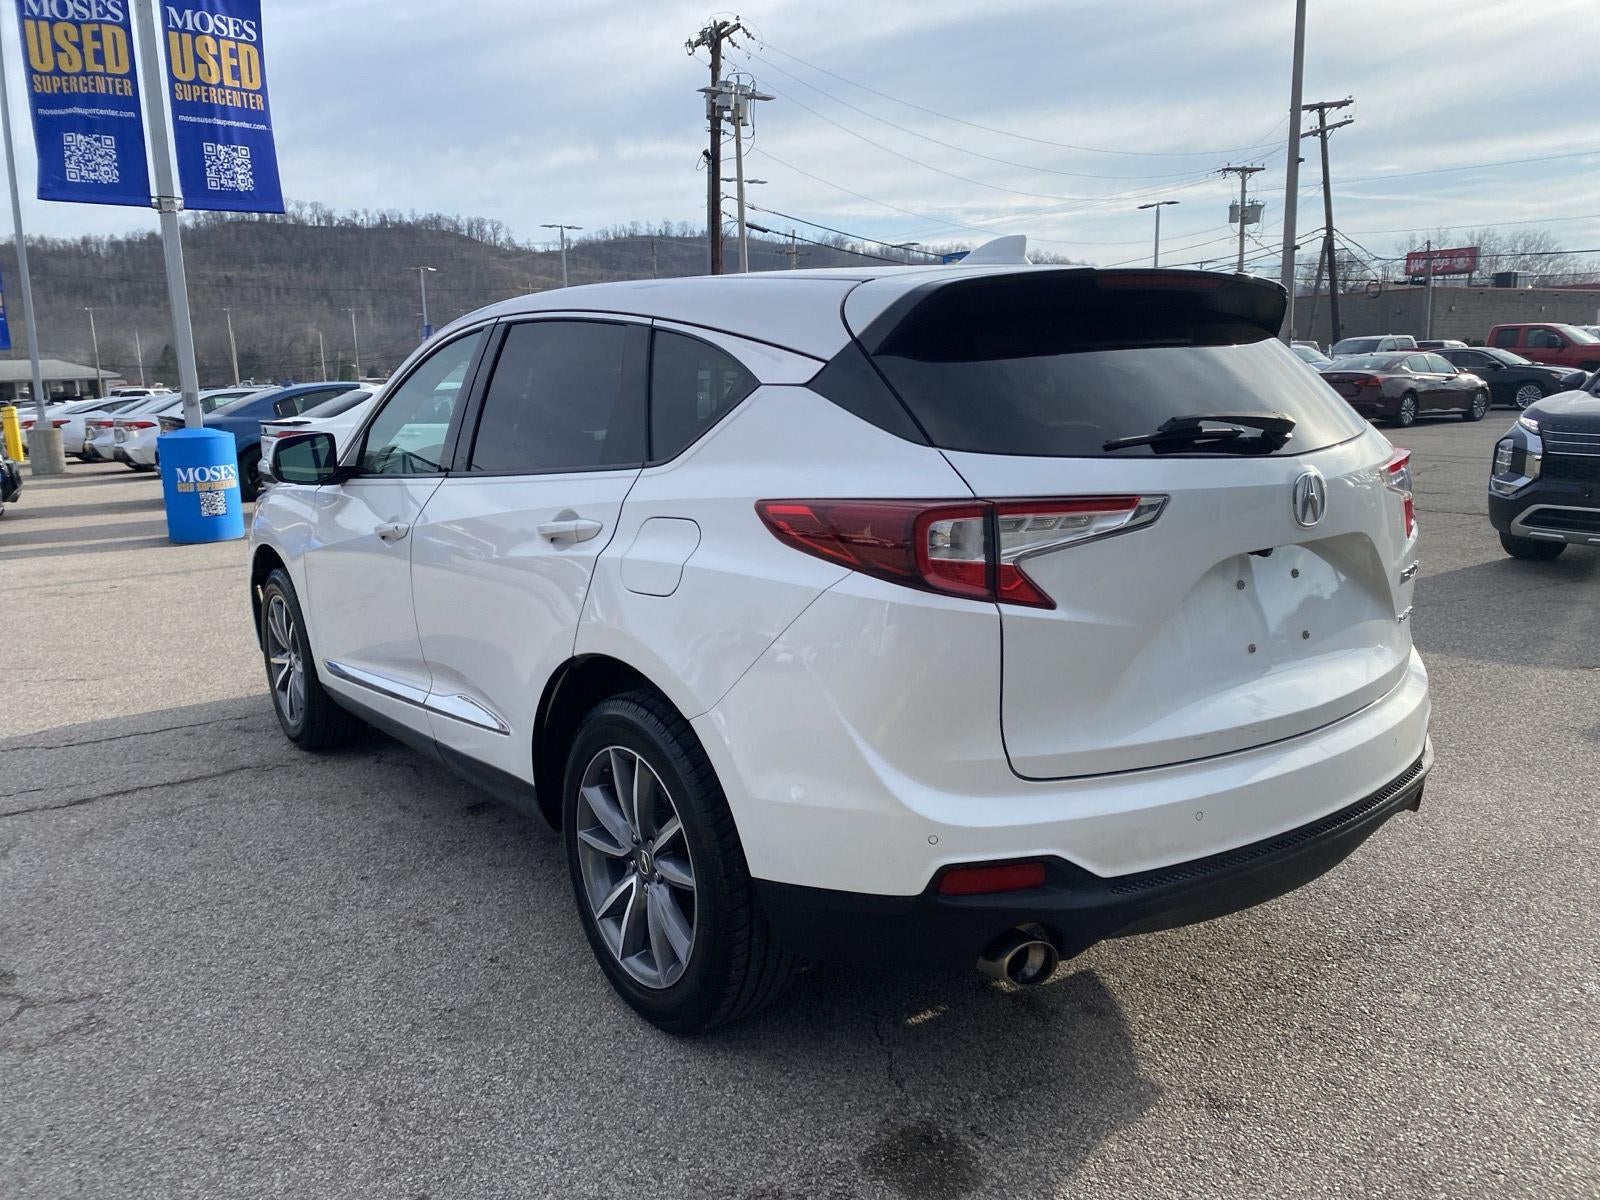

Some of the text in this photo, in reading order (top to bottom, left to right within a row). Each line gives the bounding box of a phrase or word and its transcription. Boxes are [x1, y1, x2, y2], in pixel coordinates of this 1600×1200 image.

[23, 0, 124, 22] MOSES
[166, 6, 257, 42] MOSES
[24, 19, 130, 75] USED
[168, 31, 262, 91] USED
[32, 73, 133, 97] SUPERCENTER
[174, 83, 265, 111] SUPERCENTER
[37, 107, 136, 118] mosesusedsupercenter.com
[178, 113, 268, 131] mosesusedsupercenter.com
[176, 464, 237, 483] MOSES
